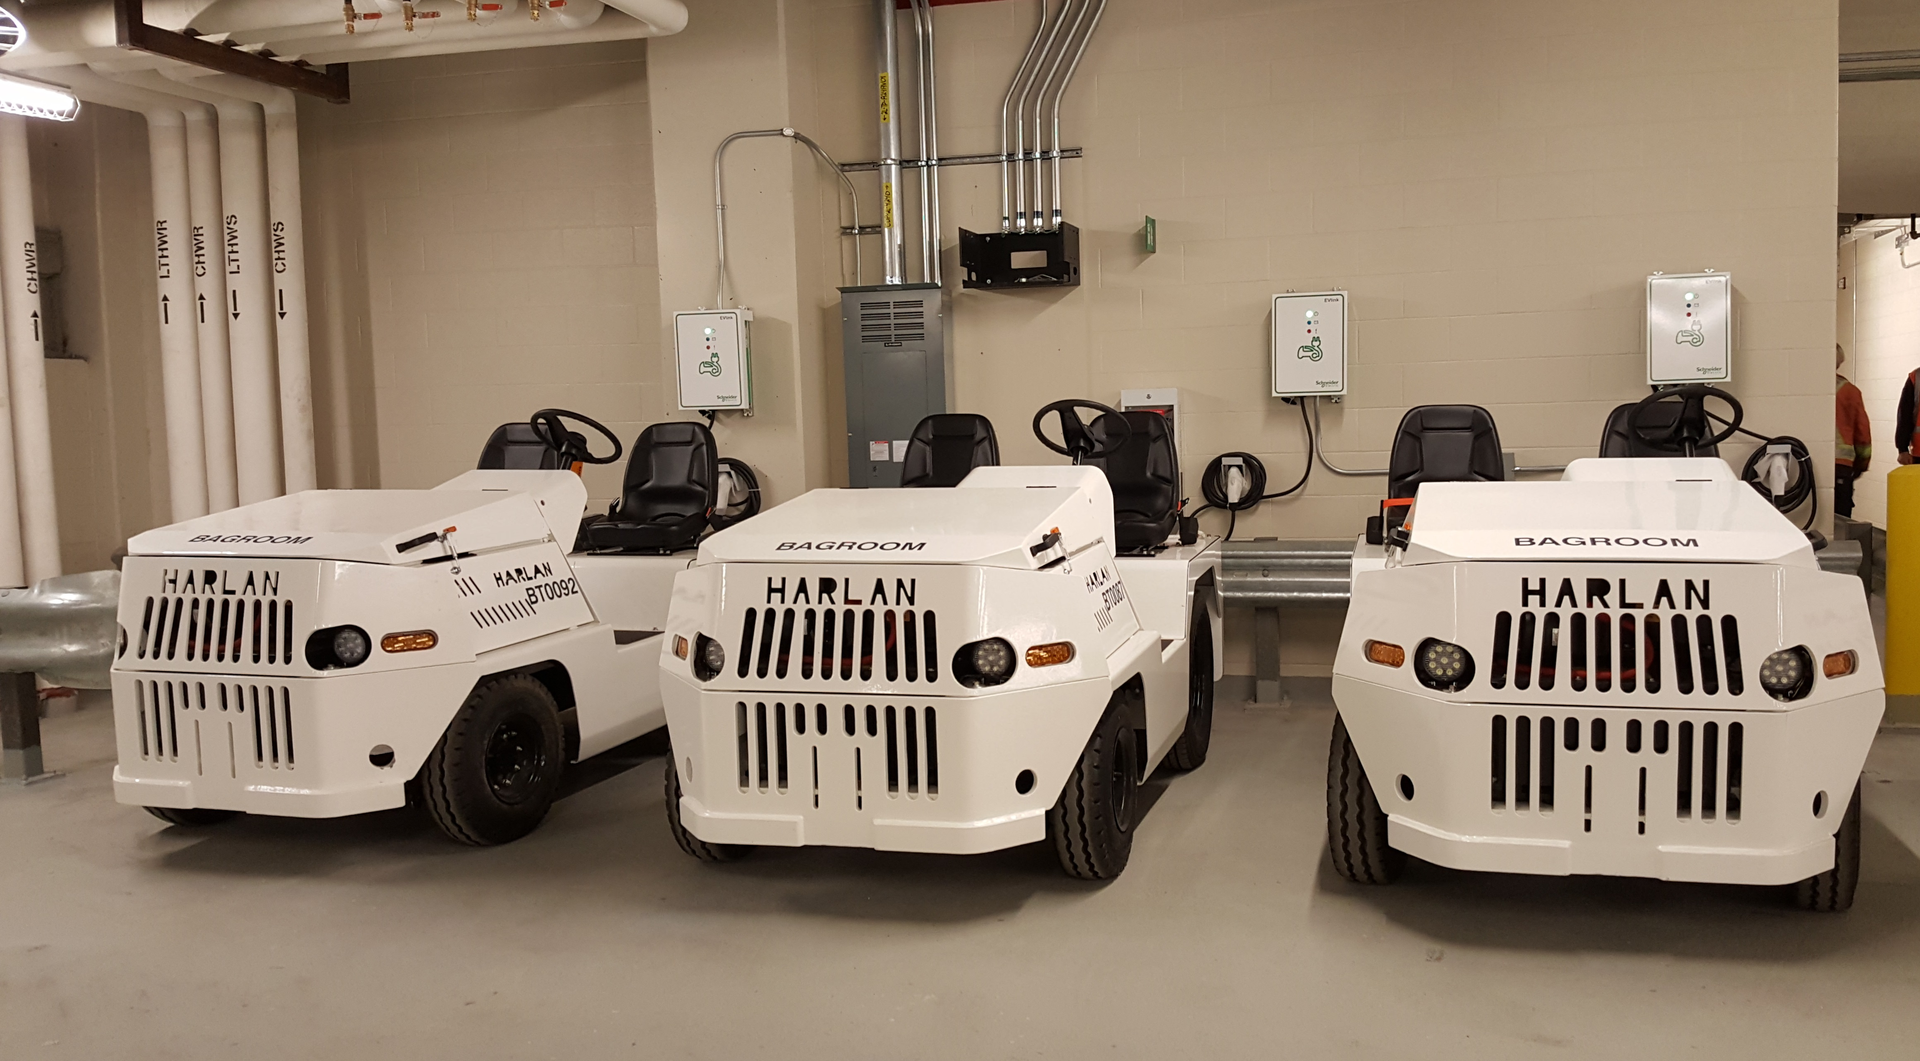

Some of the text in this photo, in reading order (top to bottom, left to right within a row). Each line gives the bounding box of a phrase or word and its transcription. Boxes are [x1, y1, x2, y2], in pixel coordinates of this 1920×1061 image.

[156, 220, 170, 278] LTHWR
[193, 226, 206, 277] CHWR
[226, 214, 240, 274] LTHWS
[273, 222, 286, 274] CHWS
[24, 241, 38, 294] CHWR
[188, 535, 313, 544] BAGROOM
[775, 542, 927, 550] BAGROOM
[1514, 537, 1699, 547] BAGROOM
[162, 569, 279, 596] HARLAN
[493, 562, 553, 588] HARLAN
[1084, 565, 1112, 594] HARLAN
[526, 578, 578, 605] BT0092
[766, 577, 916, 606] HARLAN
[1522, 577, 1710, 610] HARLAN
